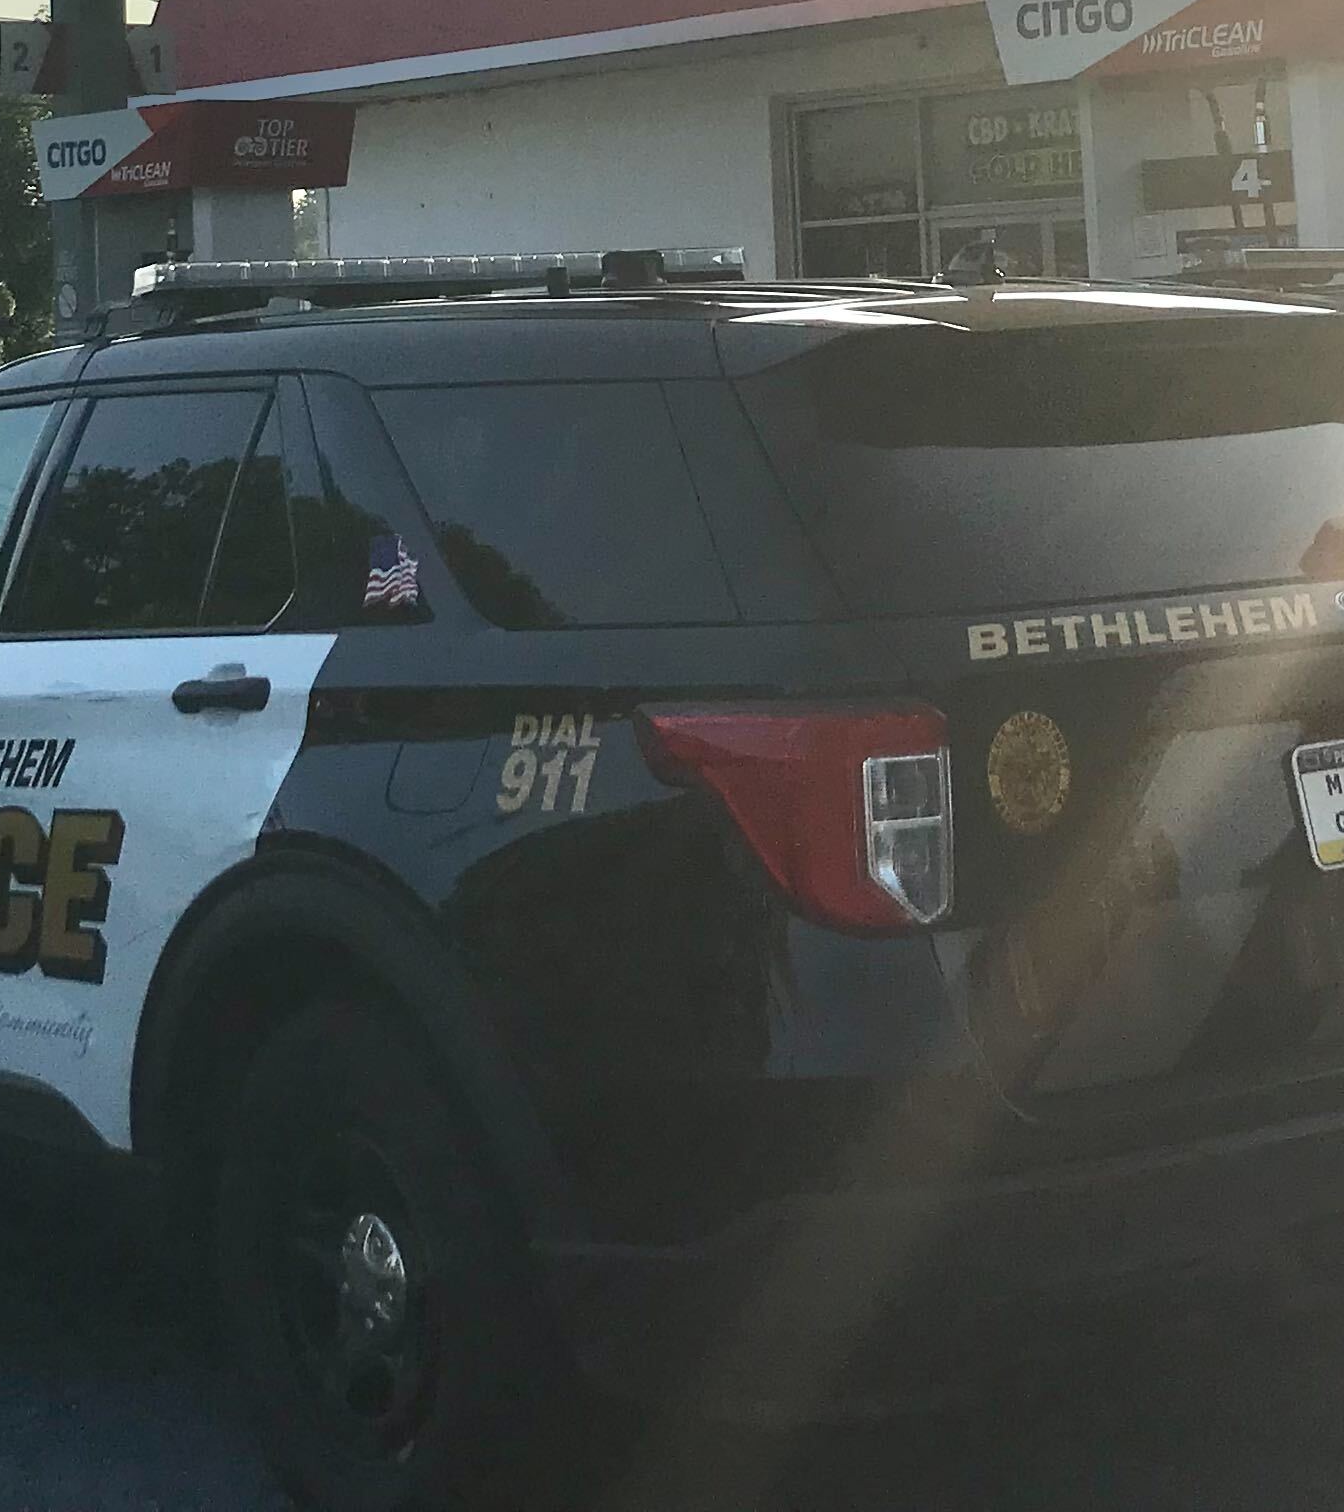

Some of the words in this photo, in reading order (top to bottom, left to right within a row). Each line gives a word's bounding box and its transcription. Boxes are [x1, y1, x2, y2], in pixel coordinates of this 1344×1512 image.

[1162, 19, 1263, 52] TriCLEAN
[13, 42, 29, 72] 2
[150, 44, 162, 73] 1
[257, 119, 295, 136] TOP
[968, 115, 1008, 144] CBD
[47, 138, 106, 169] CITGO
[270, 138, 308, 156] TIER
[1231, 158, 1271, 198] 4
[967, 592, 1318, 661] BETHLEHEM
[511, 714, 600, 747] DIAL
[496, 748, 597, 813] 911
[1325, 773, 1343, 796] M
